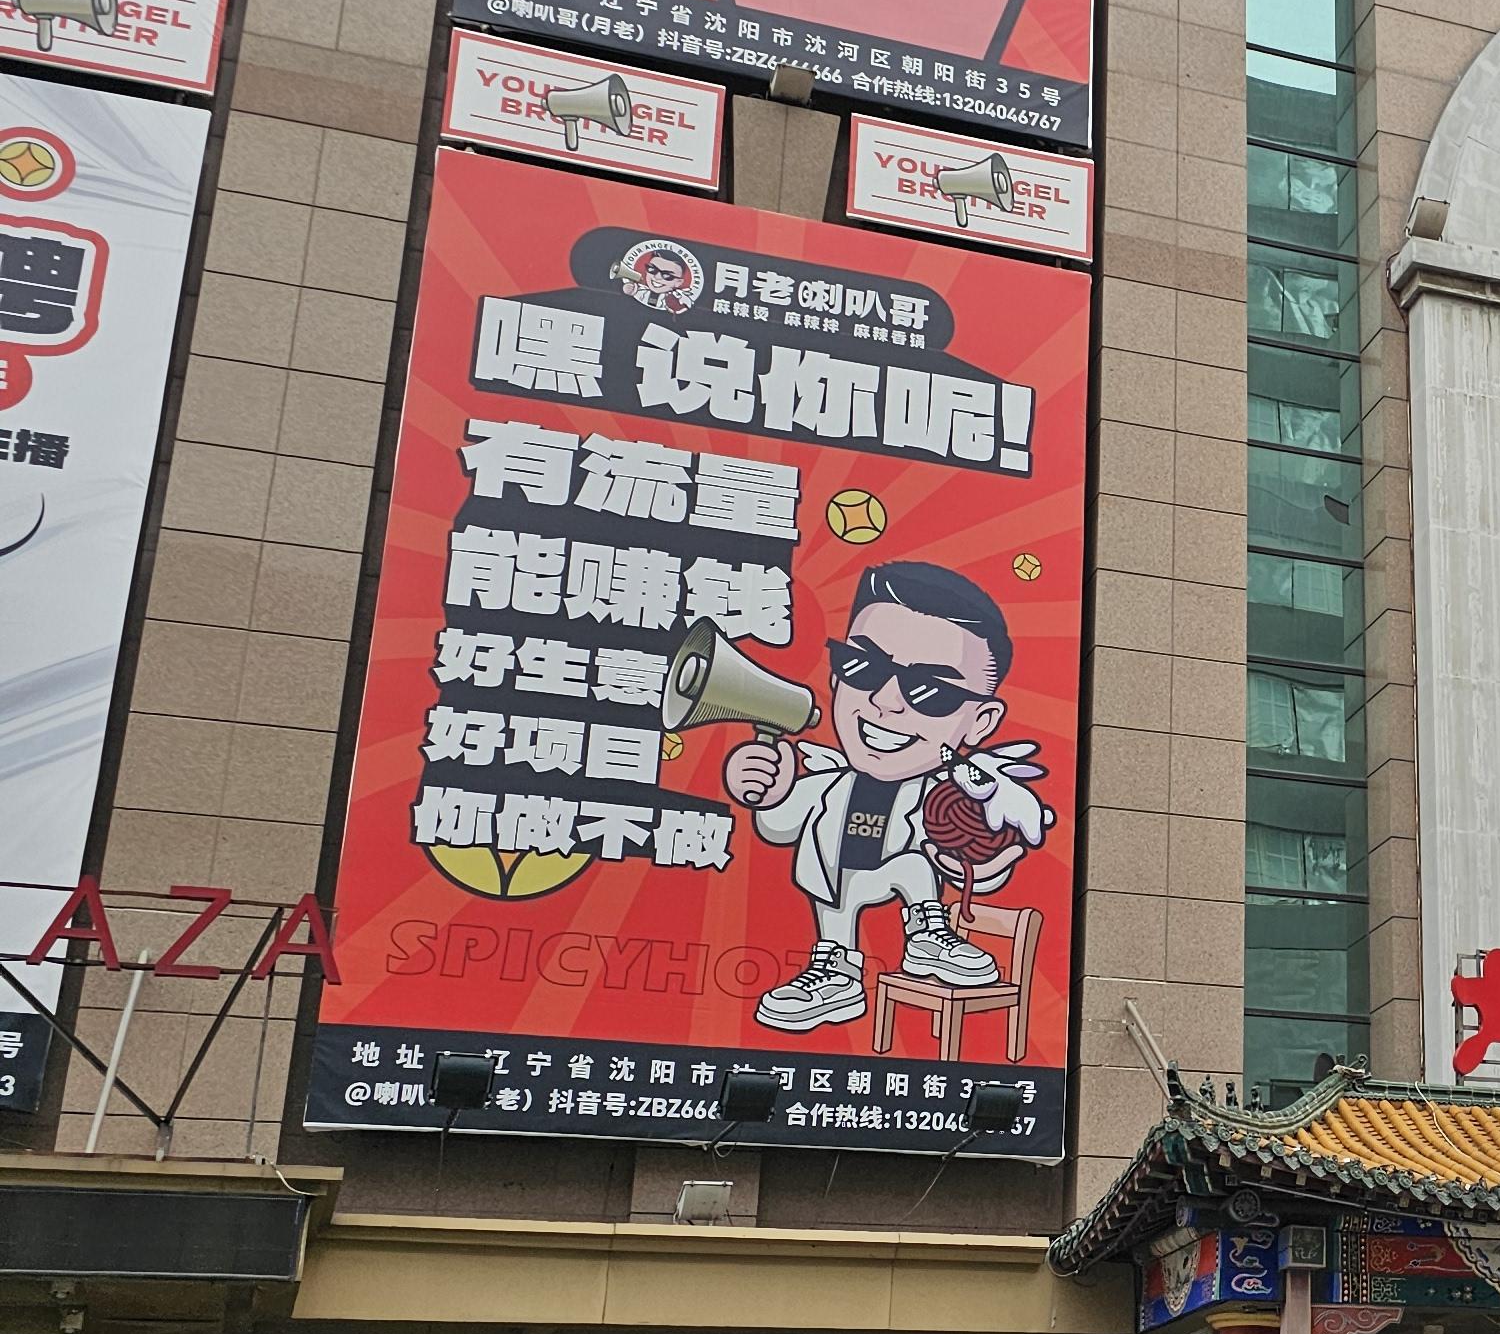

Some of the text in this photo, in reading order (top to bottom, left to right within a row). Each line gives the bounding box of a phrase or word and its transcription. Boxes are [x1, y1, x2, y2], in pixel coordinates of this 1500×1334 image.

[713, 299, 925, 350] 麻辣烫 麻辣拌 麻辣香锅
[714, 262, 930, 330] 月老喇叭哥
[480, 297, 604, 398] 嘿
[461, 419, 801, 540] 有流量
[446, 525, 794, 645] 能赚钱
[435, 626, 668, 708] 好生意
[426, 706, 661, 785] 好项目
[414, 785, 733, 871] 你做不做
